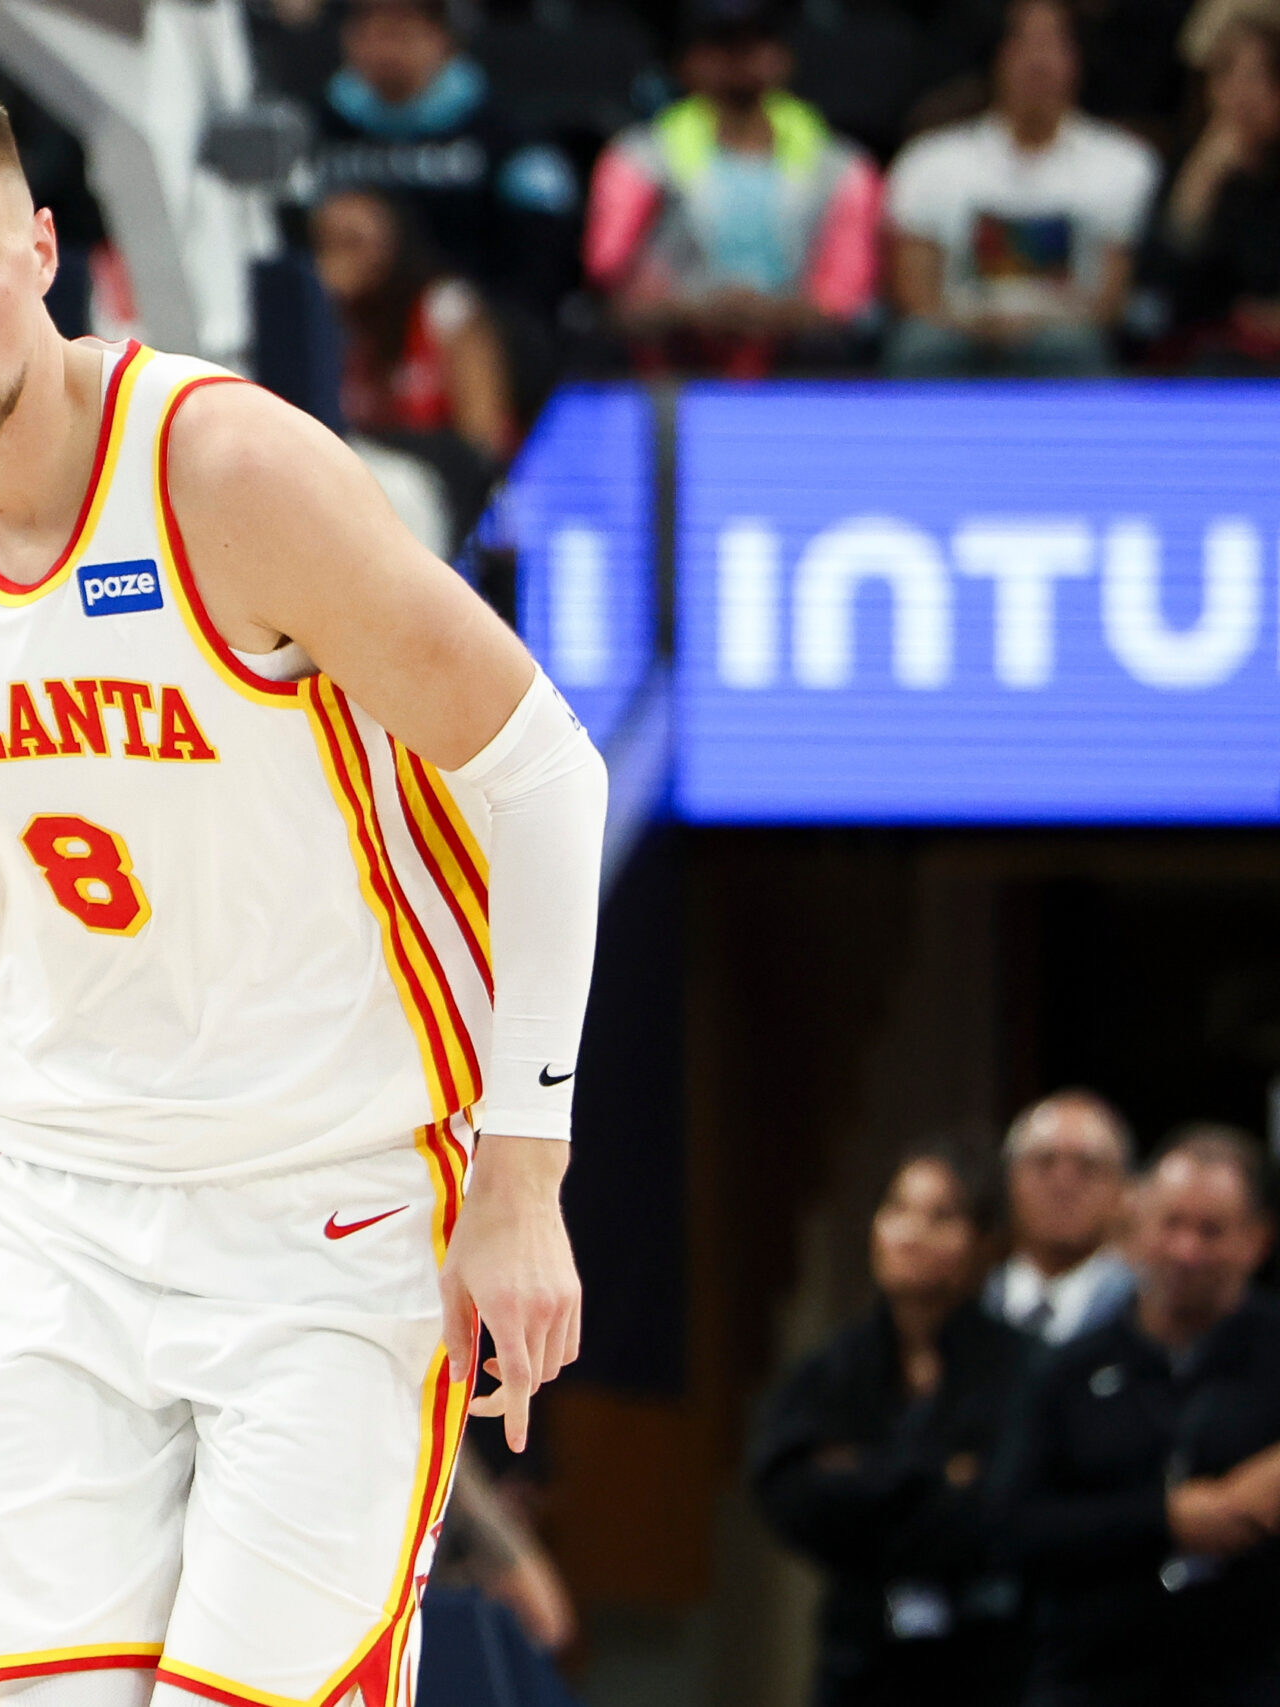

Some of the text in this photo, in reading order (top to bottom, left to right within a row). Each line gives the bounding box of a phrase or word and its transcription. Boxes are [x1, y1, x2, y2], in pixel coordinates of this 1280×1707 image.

[84, 571, 156, 606] paze
[718, 518, 1280, 690] INTU
[19, 812, 153, 938] 8
